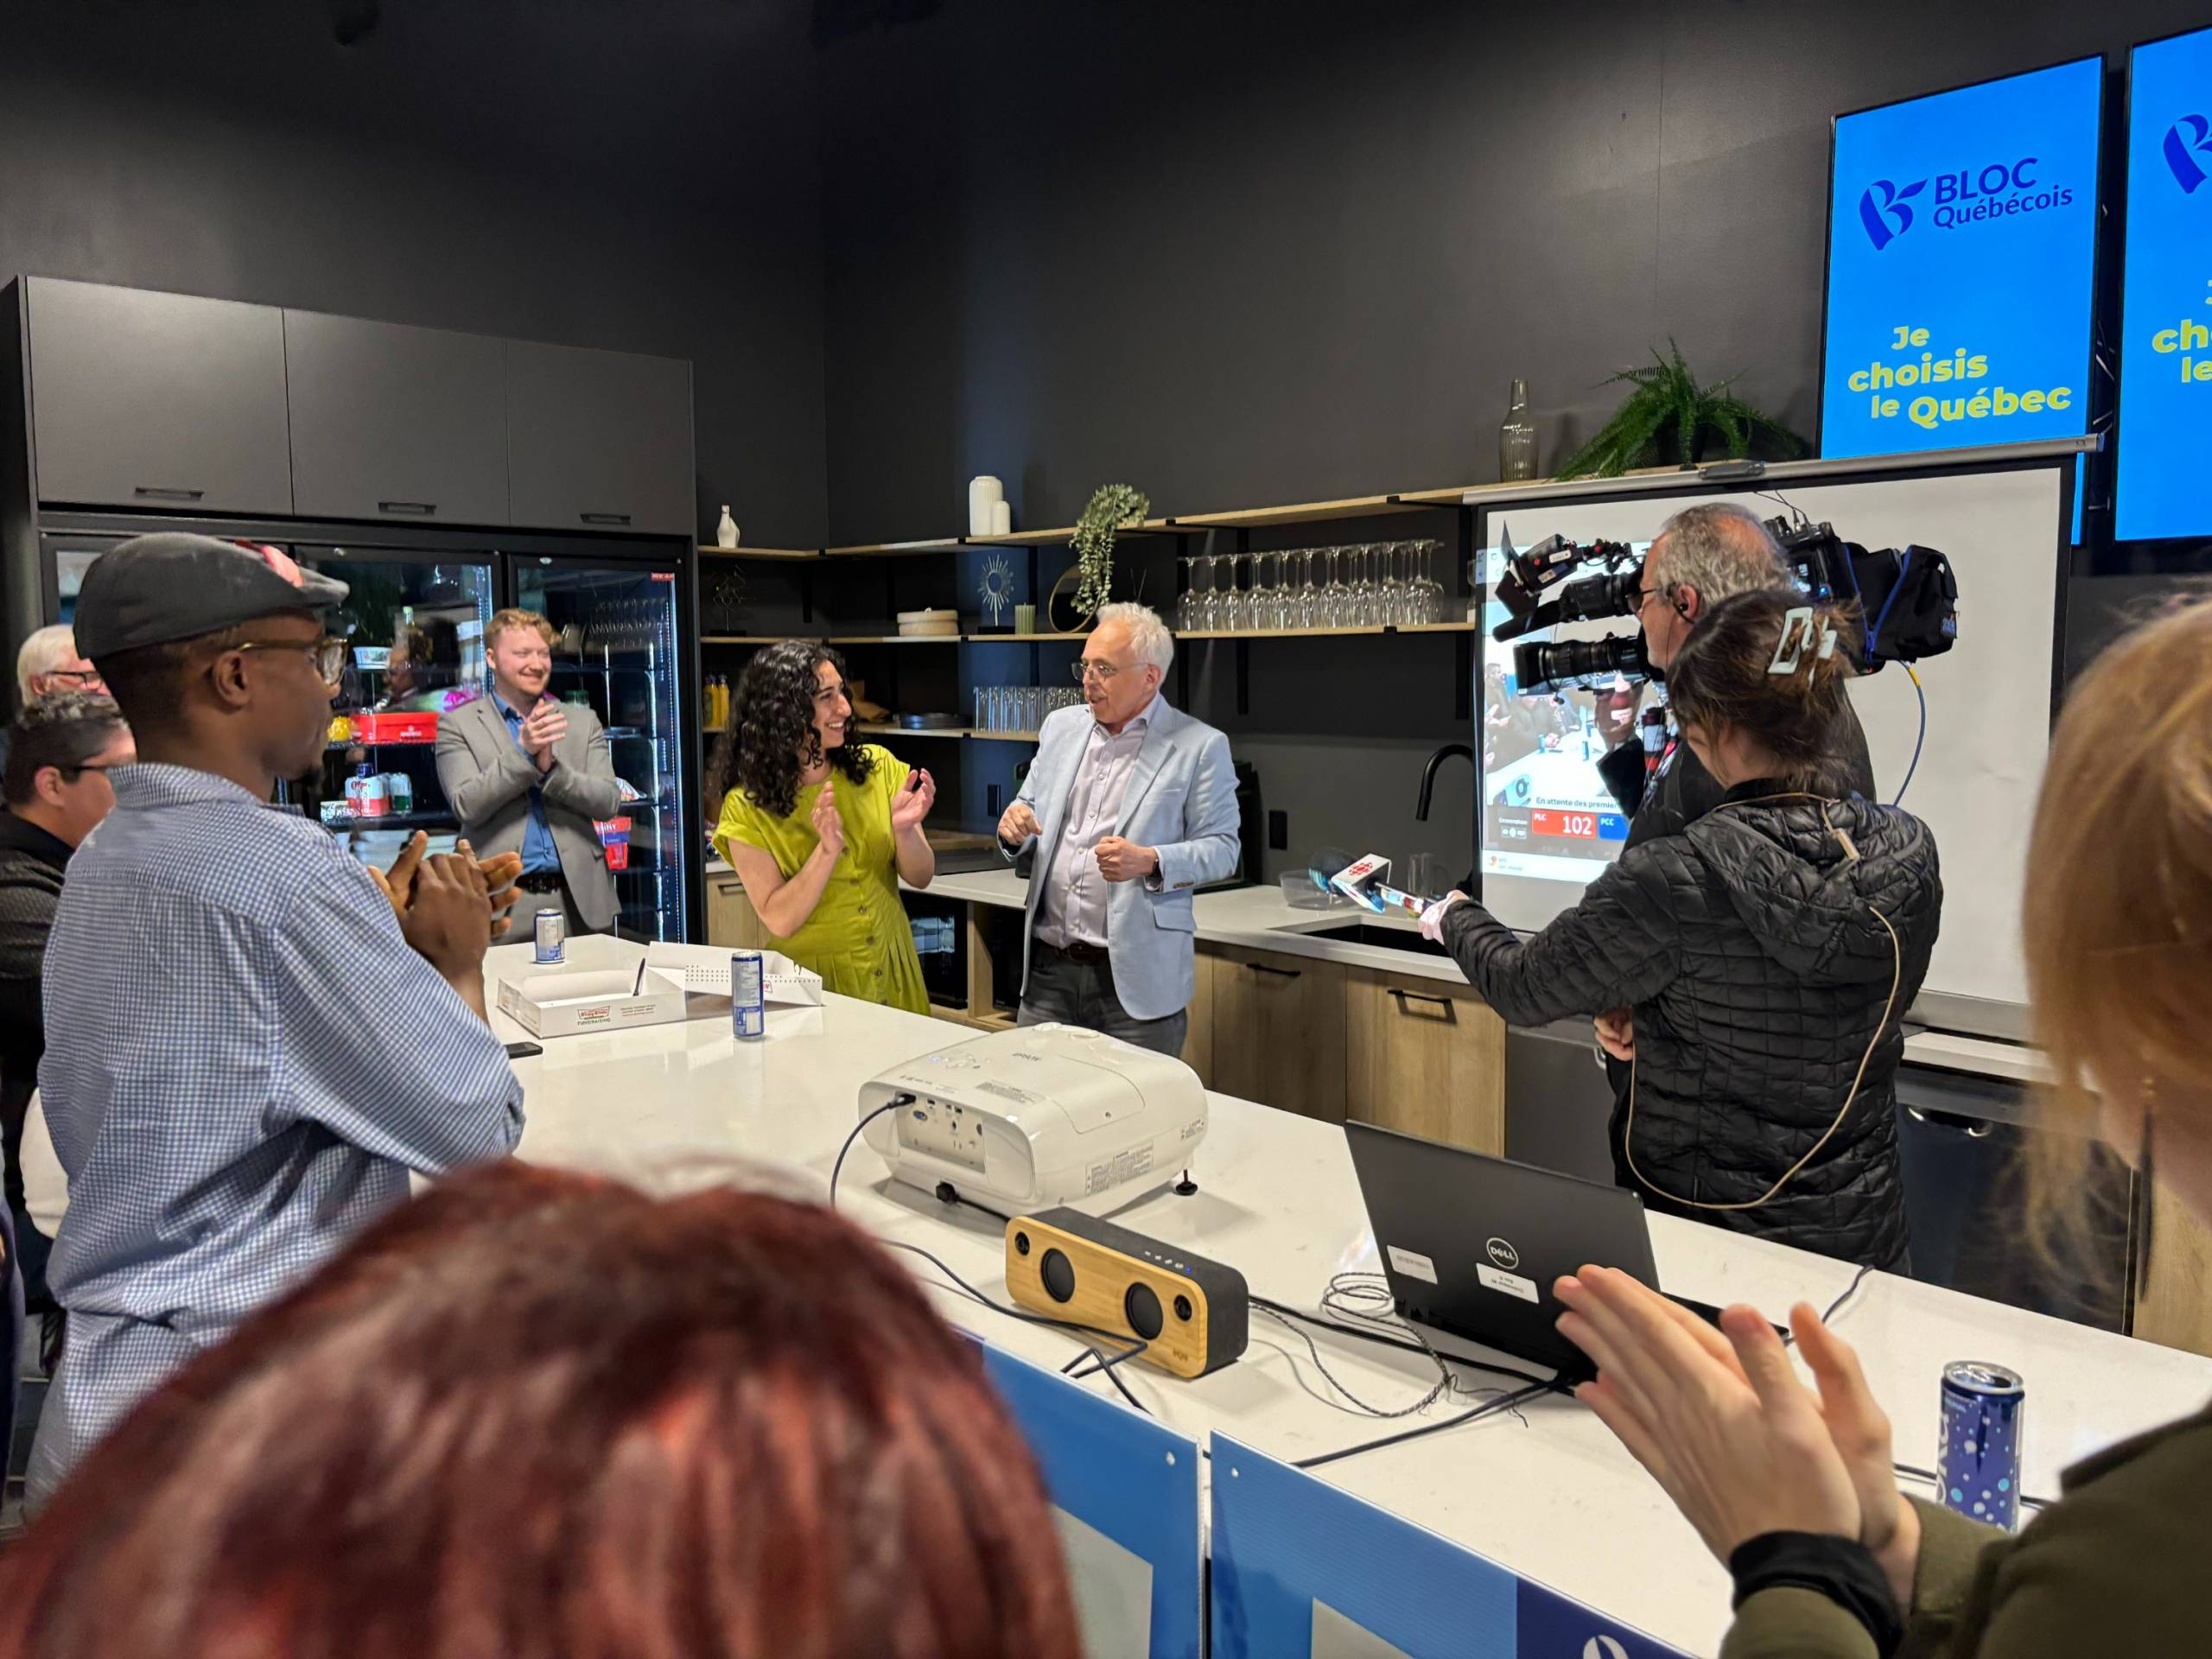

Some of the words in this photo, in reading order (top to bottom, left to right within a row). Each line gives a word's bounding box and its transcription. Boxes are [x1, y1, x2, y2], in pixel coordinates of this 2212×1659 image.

[1934, 157, 2039, 206] BLOC
[1933, 184, 2074, 230] Québécois
[1891, 326, 1930, 350] Je
[2152, 318, 2212, 353] ch
[1847, 347, 1988, 392] choisis
[1870, 395, 1900, 419] le
[1907, 386, 2073, 429] Québec
[1534, 812, 1547, 822] PLC
[1561, 815, 1592, 836] 102
[1600, 817, 1615, 827] PCC
[1490, 1245, 1516, 1262] DELL
